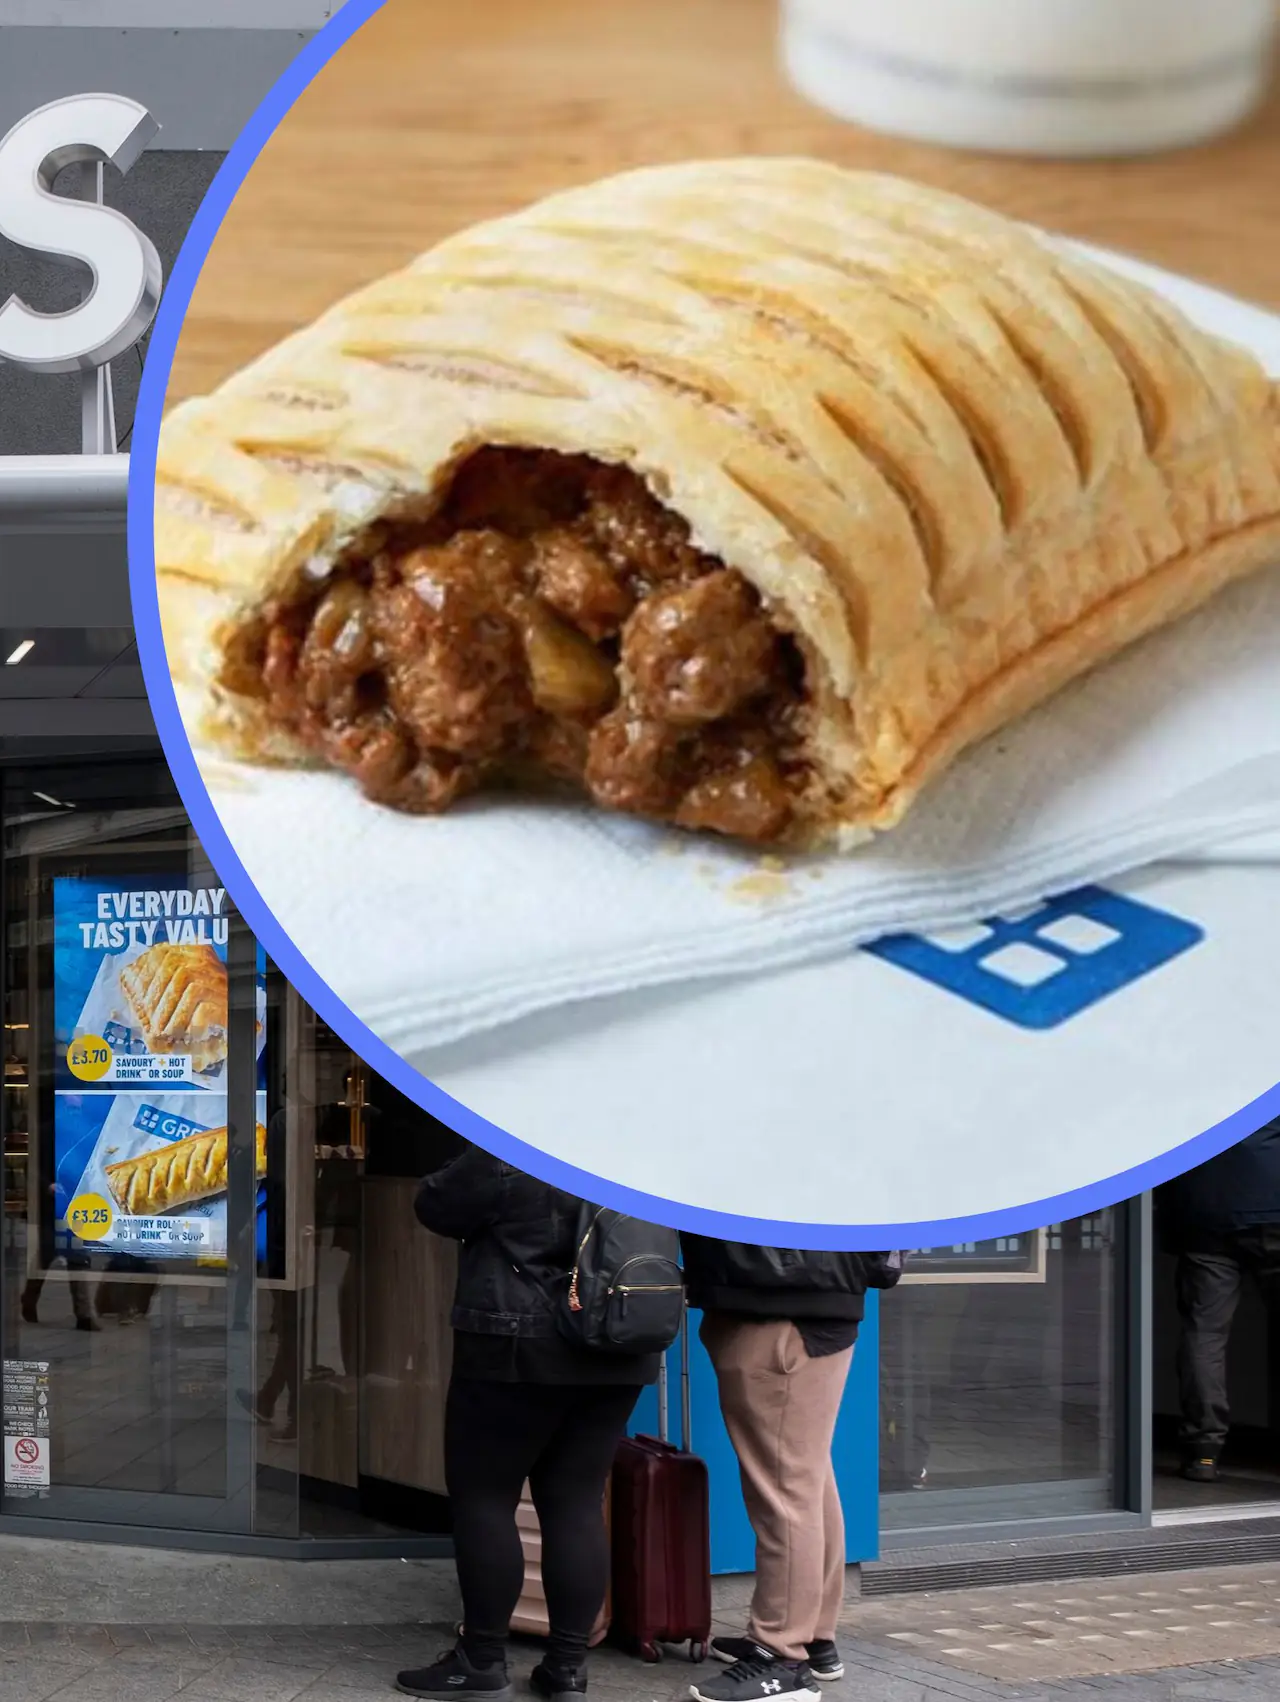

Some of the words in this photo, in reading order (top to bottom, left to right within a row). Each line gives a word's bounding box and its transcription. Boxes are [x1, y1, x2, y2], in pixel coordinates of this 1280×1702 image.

[97, 888, 226, 920] EVERYDAY
[79, 921, 158, 949] TASTY
[72, 1048, 108, 1065] £3.70
[169, 1058, 186, 1067] HOT
[148, 1069, 160, 1078] OR
[162, 1069, 184, 1078] SOUP
[72, 1208, 108, 1223] £3.25
